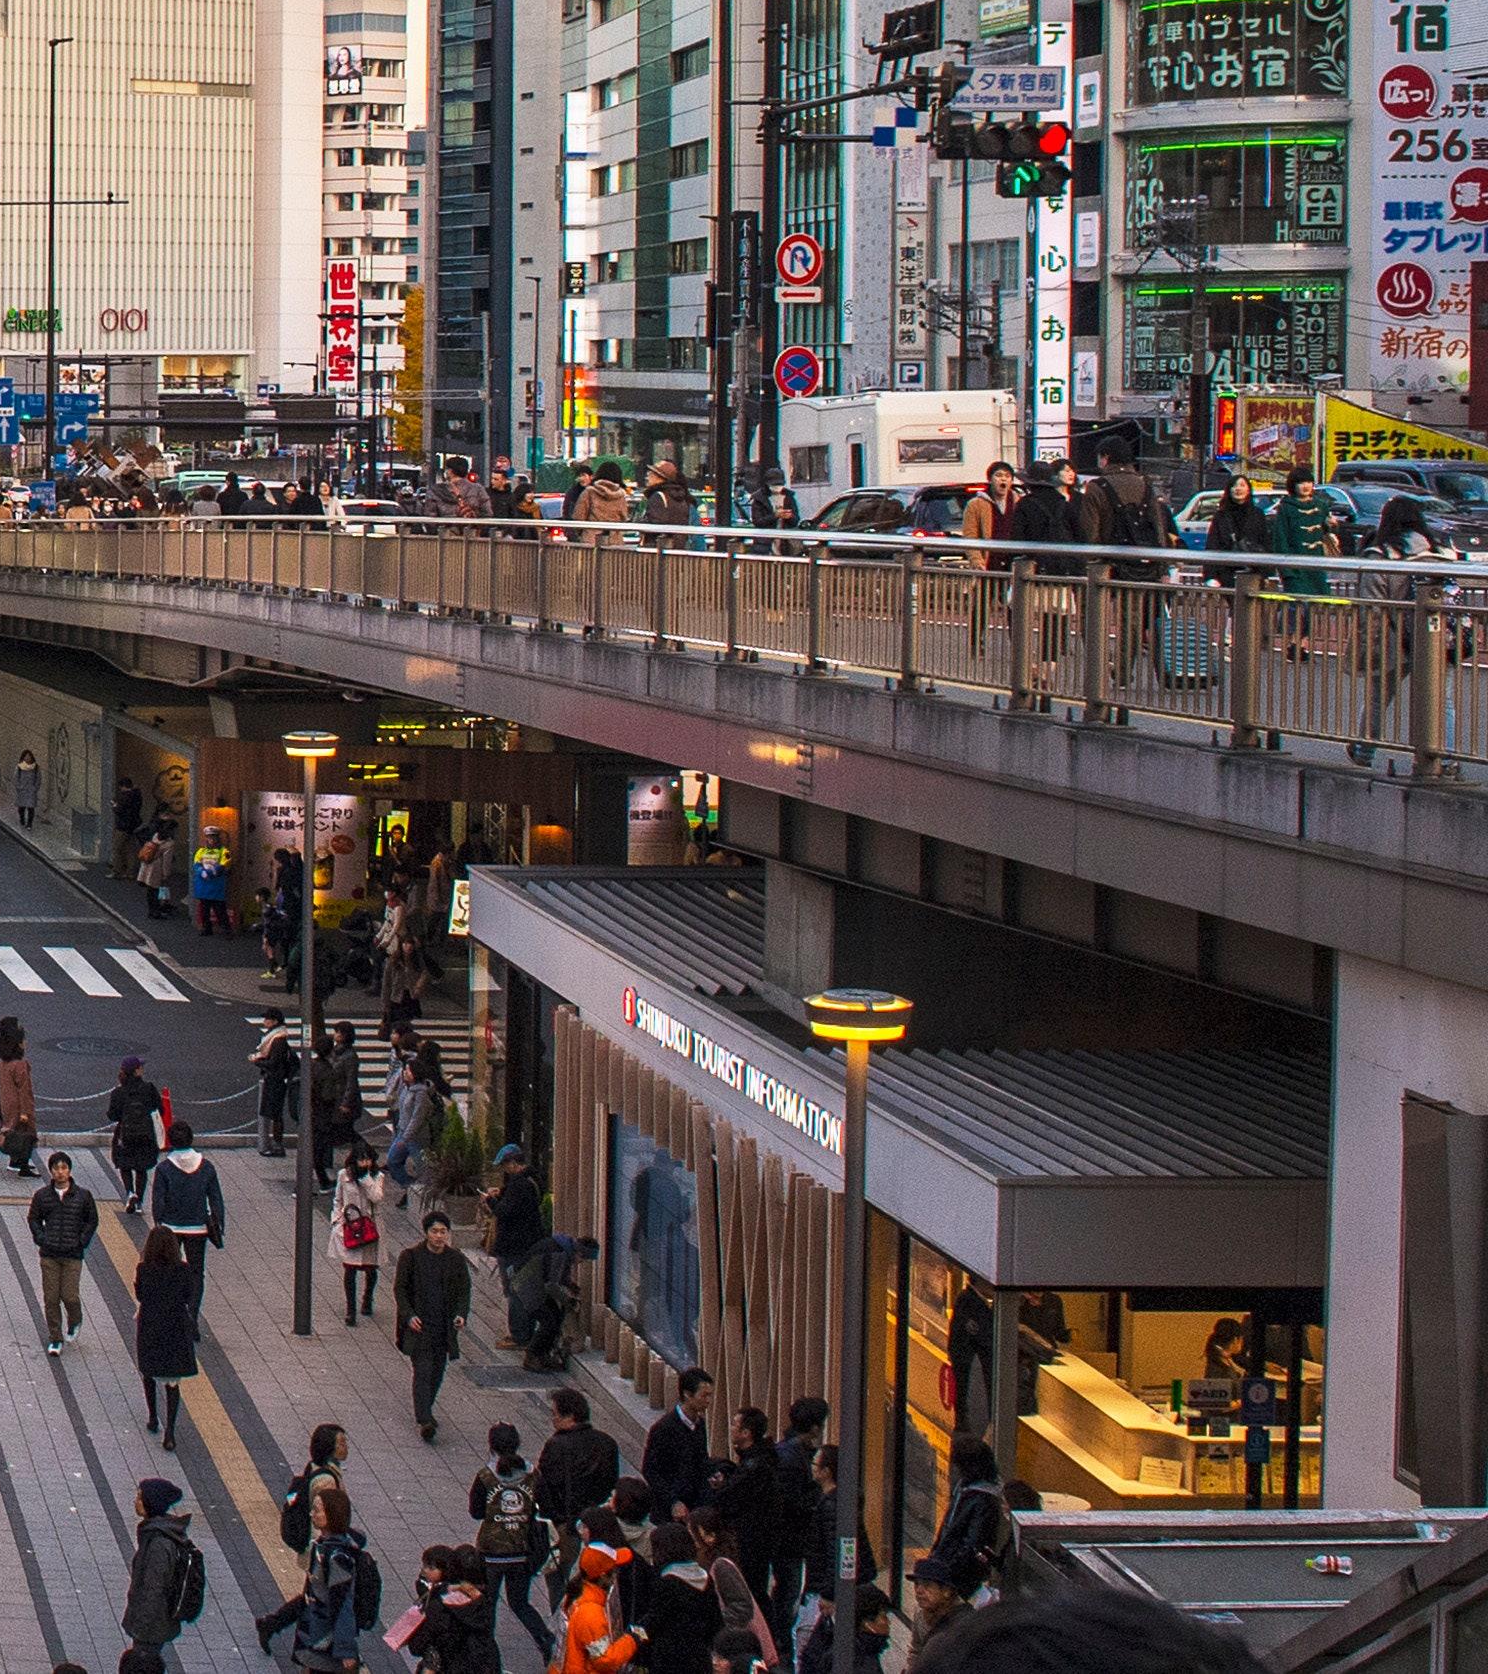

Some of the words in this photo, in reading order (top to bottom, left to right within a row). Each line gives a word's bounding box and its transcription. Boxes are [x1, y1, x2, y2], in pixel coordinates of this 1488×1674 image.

[1148, 49, 1288, 92] 安心お宿
[1003, 94, 1019, 104] Bus
[1023, 94, 1056, 104] Terminal
[1384, 201, 1443, 221] 最新式
[1334, 431, 1419, 447] ヨコチケに
[636, 997, 690, 1058] SHINJUKU
[692, 1029, 742, 1091] TOURIST
[745, 1057, 843, 1154] INFORMATION
